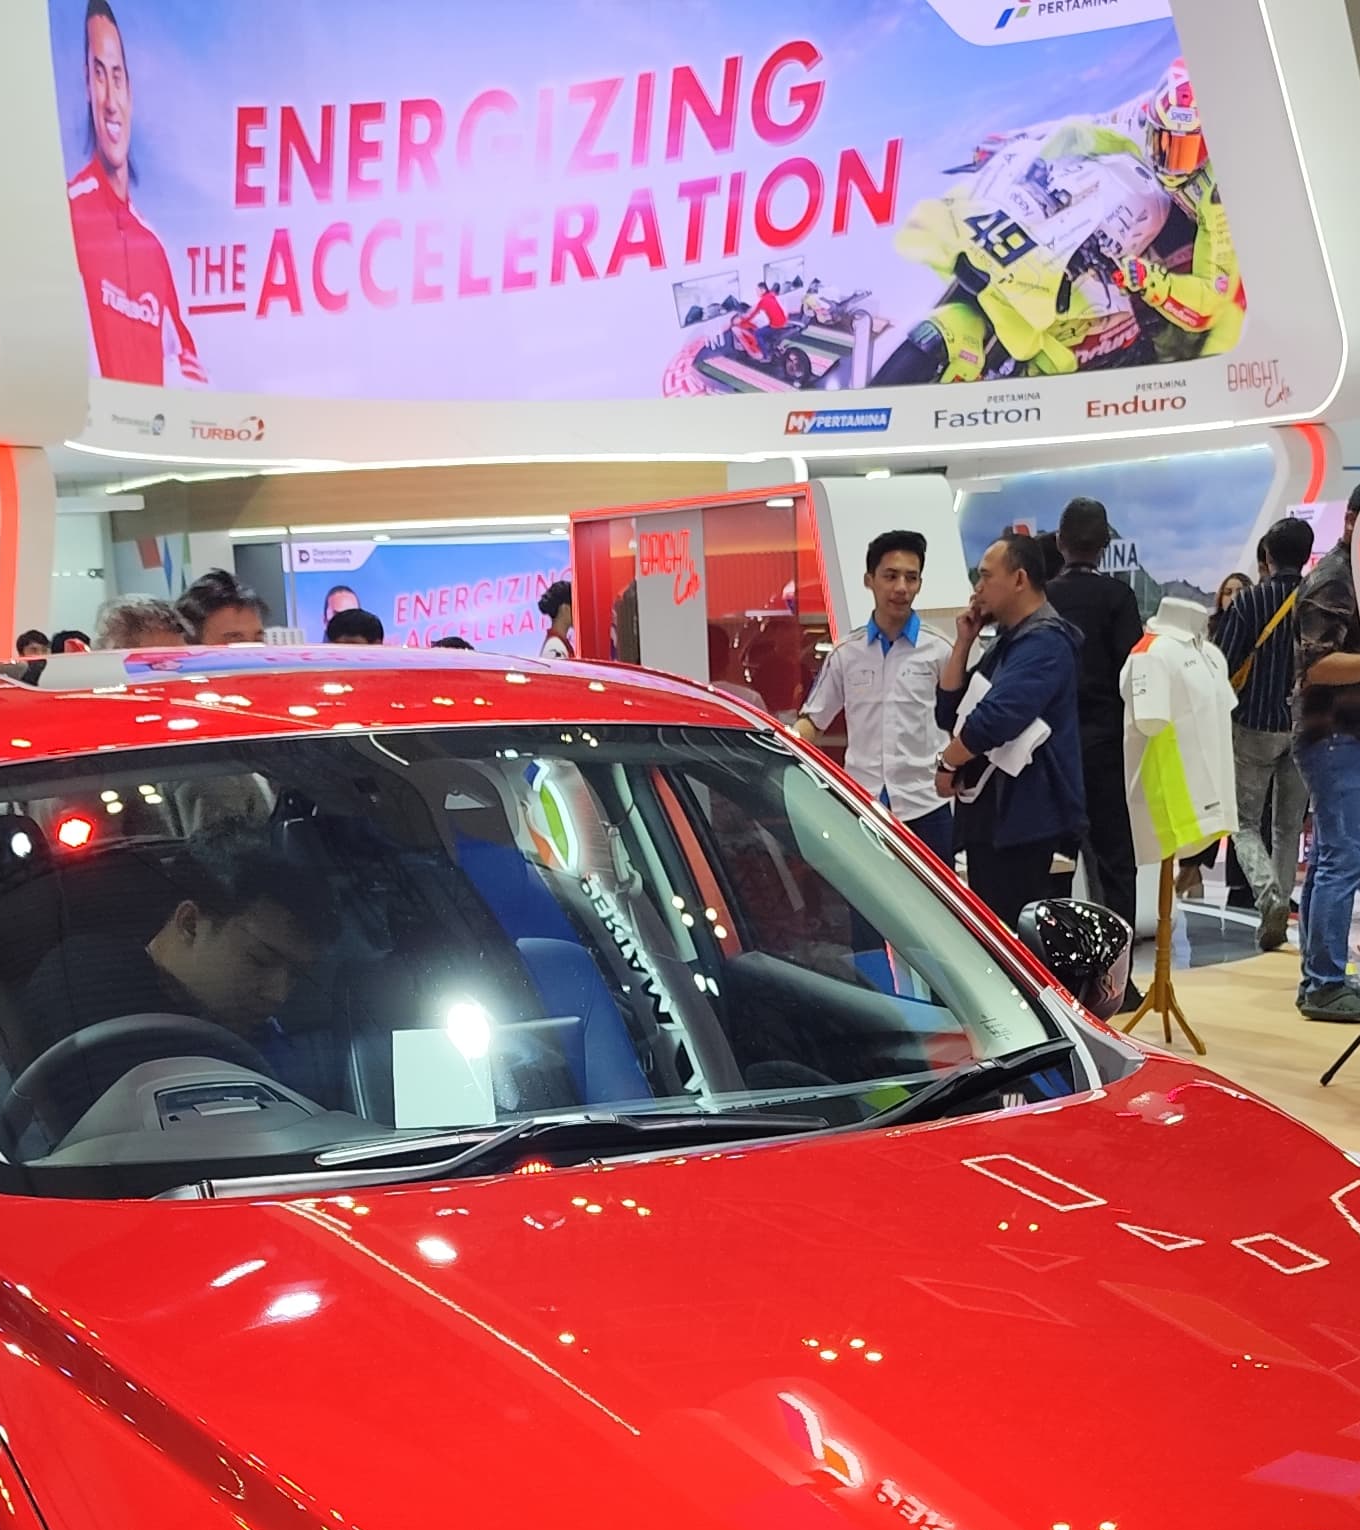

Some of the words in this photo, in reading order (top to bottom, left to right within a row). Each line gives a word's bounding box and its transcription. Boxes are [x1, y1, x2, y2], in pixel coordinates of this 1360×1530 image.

[234, 40, 825, 209] ENERGIZING
[187, 243, 247, 296] THE
[255, 136, 903, 319] ACCELERATION
[1136, 378, 1187, 392] PERTAMINA
[1227, 359, 1279, 393] BRIGHT
[986, 391, 1041, 404] PERTAMINA
[1086, 395, 1187, 419] Enduro
[933, 407, 1041, 429] Fastron
[190, 427, 253, 442] TURBO
